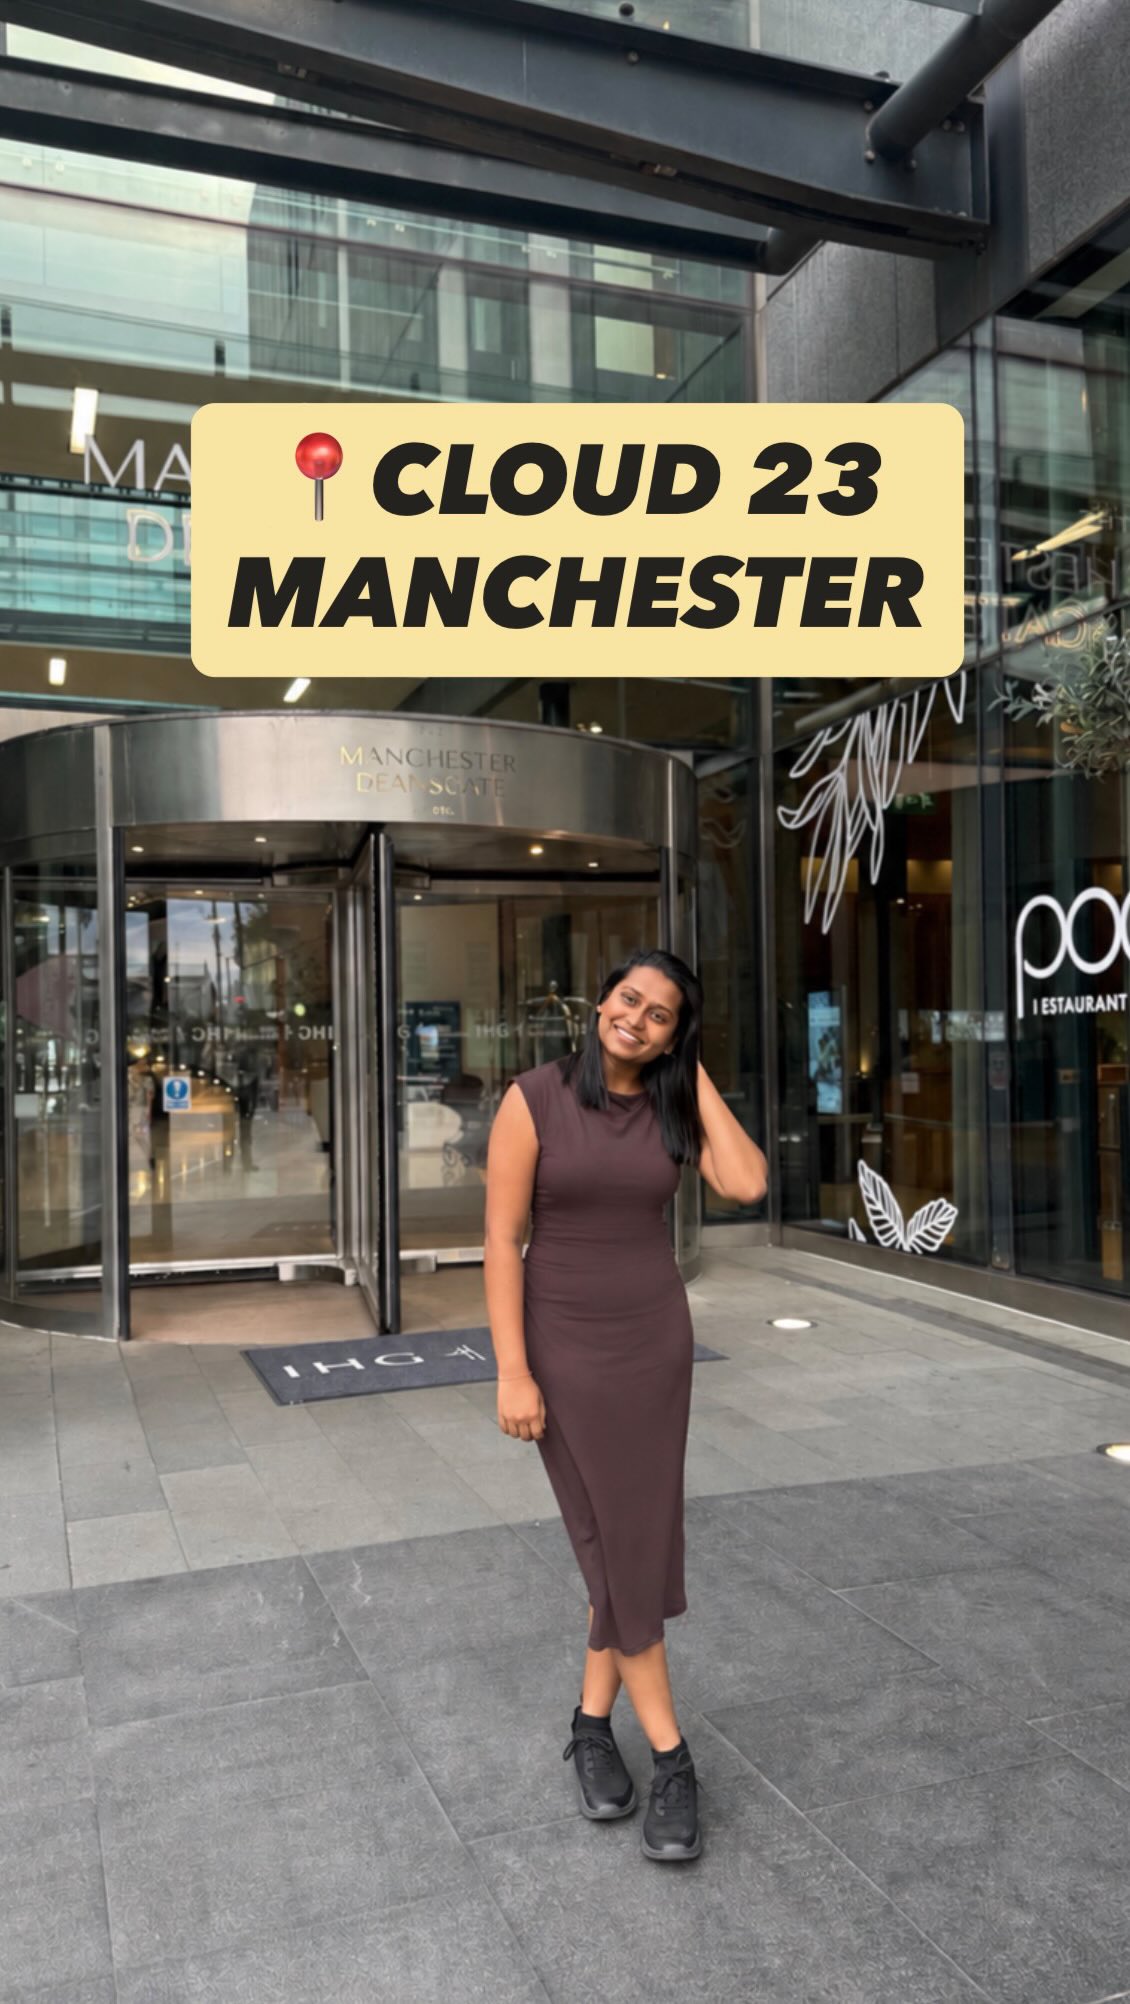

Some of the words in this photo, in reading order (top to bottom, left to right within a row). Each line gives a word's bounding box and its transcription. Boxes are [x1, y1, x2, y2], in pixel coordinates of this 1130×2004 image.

[340, 745, 516, 773] MANCHESTER
[1015, 886, 1130, 1019] po
[283, 1353, 424, 1378] IHG
